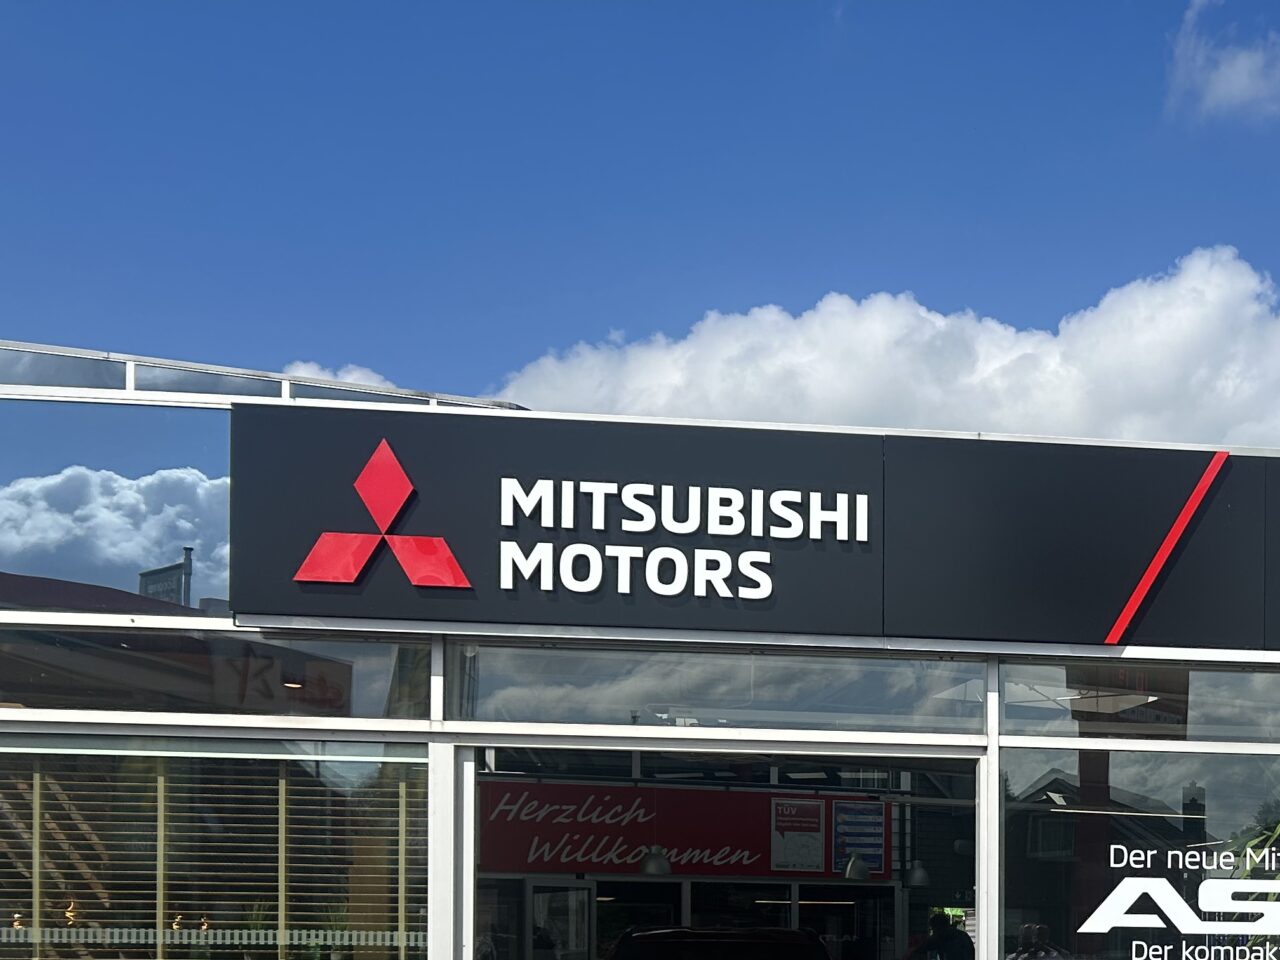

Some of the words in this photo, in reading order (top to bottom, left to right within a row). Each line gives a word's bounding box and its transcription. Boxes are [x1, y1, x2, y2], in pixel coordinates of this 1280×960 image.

[500, 477, 869, 542] MITSUBISHI
[500, 540, 773, 600] MOTORS
[489, 791, 656, 826] Herzlich
[777, 804, 797, 815] TÜV
[1109, 845, 1157, 869] Der
[1167, 849, 1235, 870] neue
